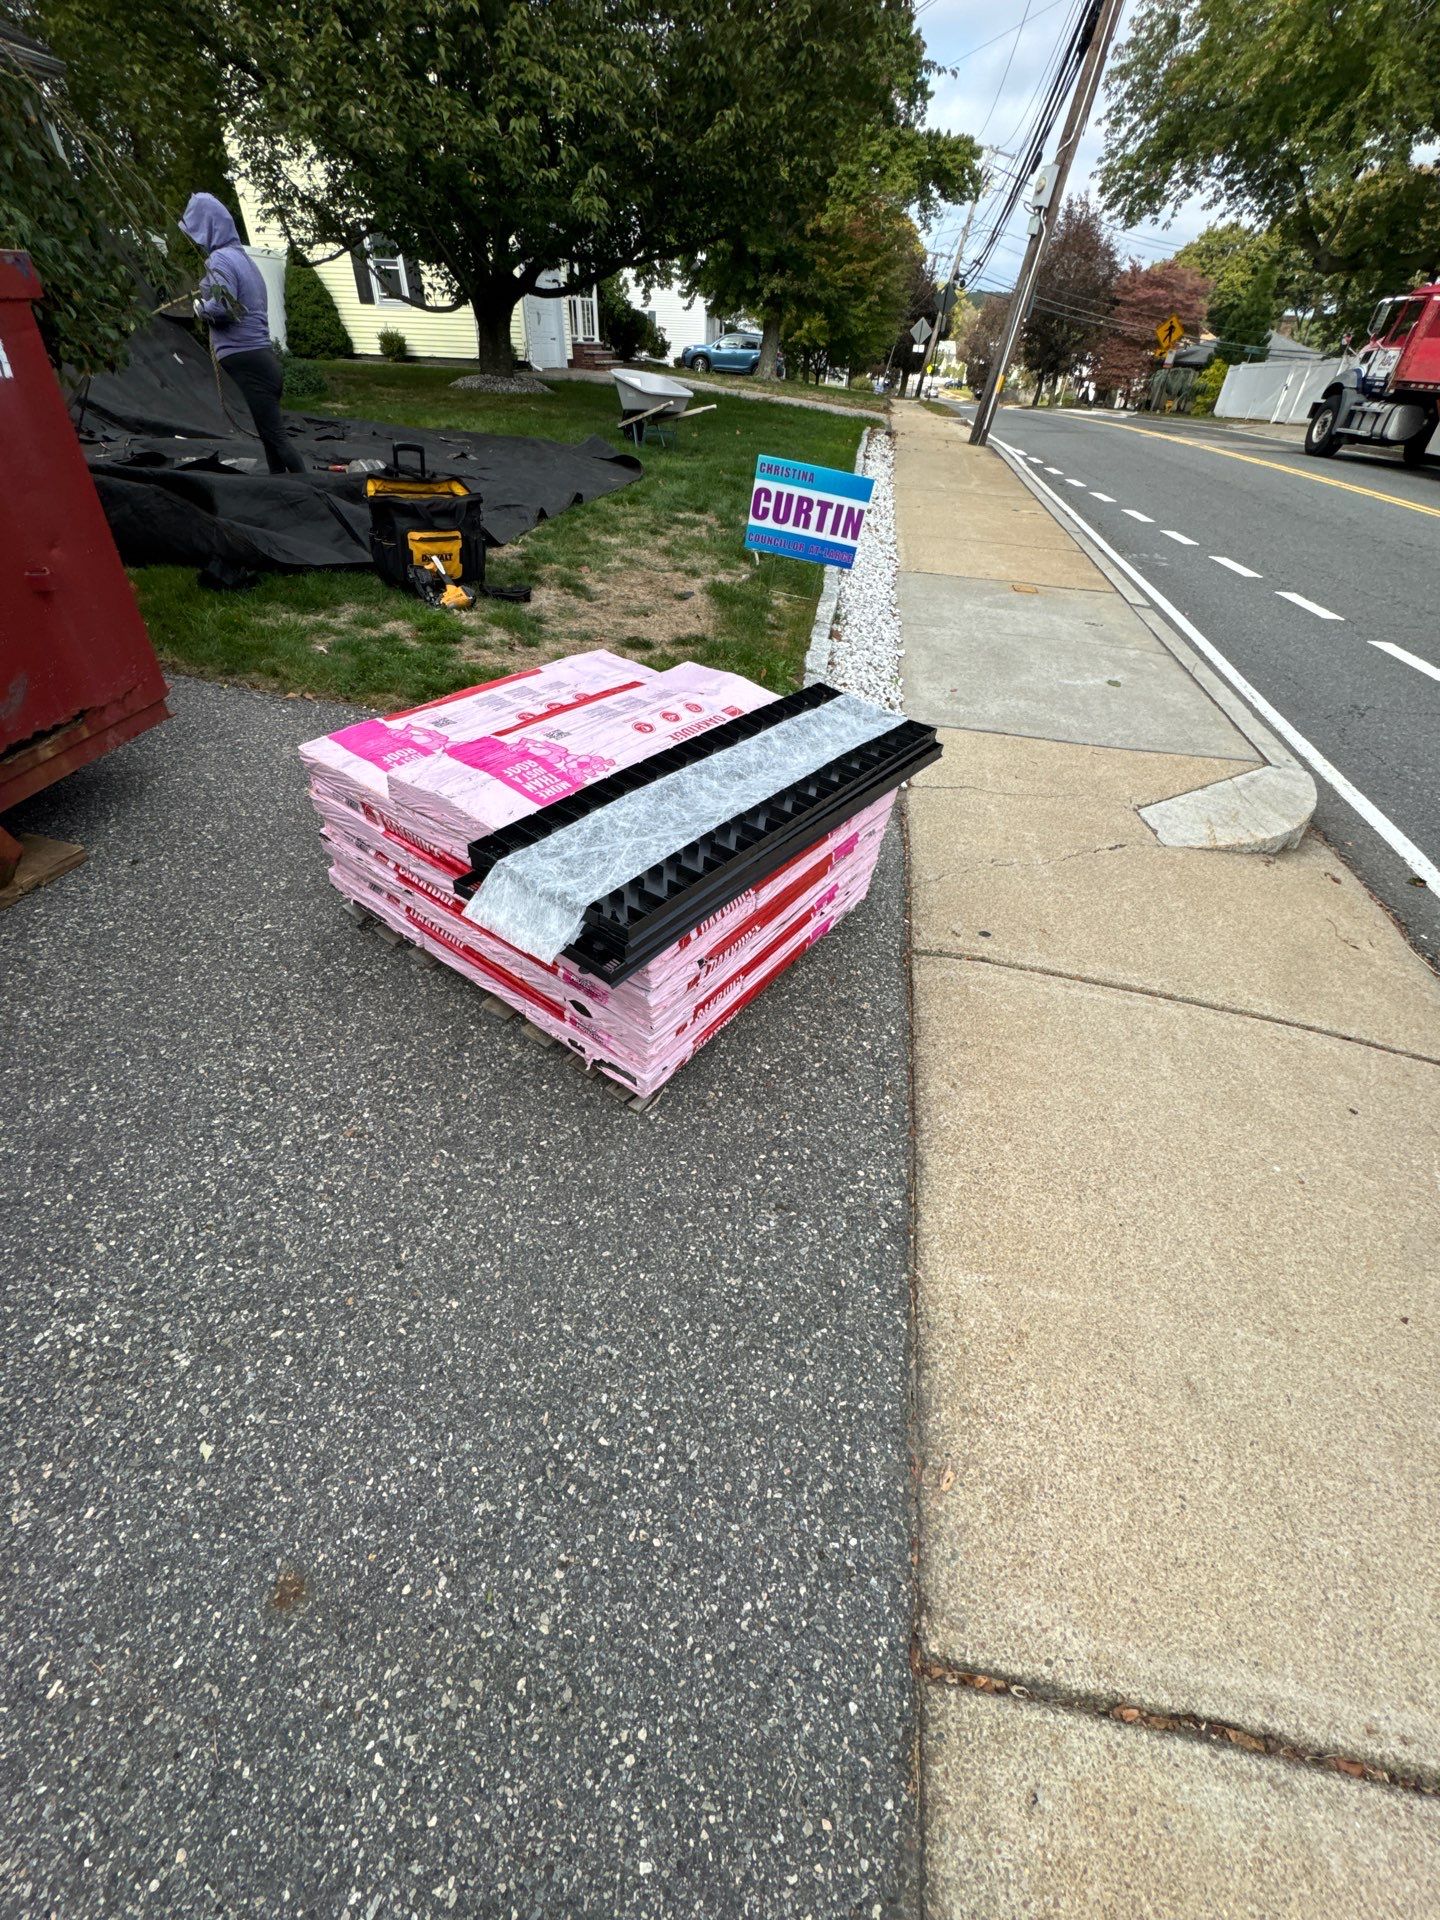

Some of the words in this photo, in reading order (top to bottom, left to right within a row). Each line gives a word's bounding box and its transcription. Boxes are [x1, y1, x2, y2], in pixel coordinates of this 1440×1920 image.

[759, 462, 815, 484] CHRISTINA
[751, 487, 865, 541] CURTIN
[748, 533, 805, 552] COUNCILLOR
[808, 544, 853, 563] AT-LARGE
[667, 715, 726, 742] OAKRIDGE
[381, 747, 417, 765] ROOF
[502, 759, 539, 778] ROOF
[524, 766, 547, 781] JUST
[511, 775, 523, 784] A
[521, 774, 560, 794] THAN
[533, 781, 573, 801] MORE
